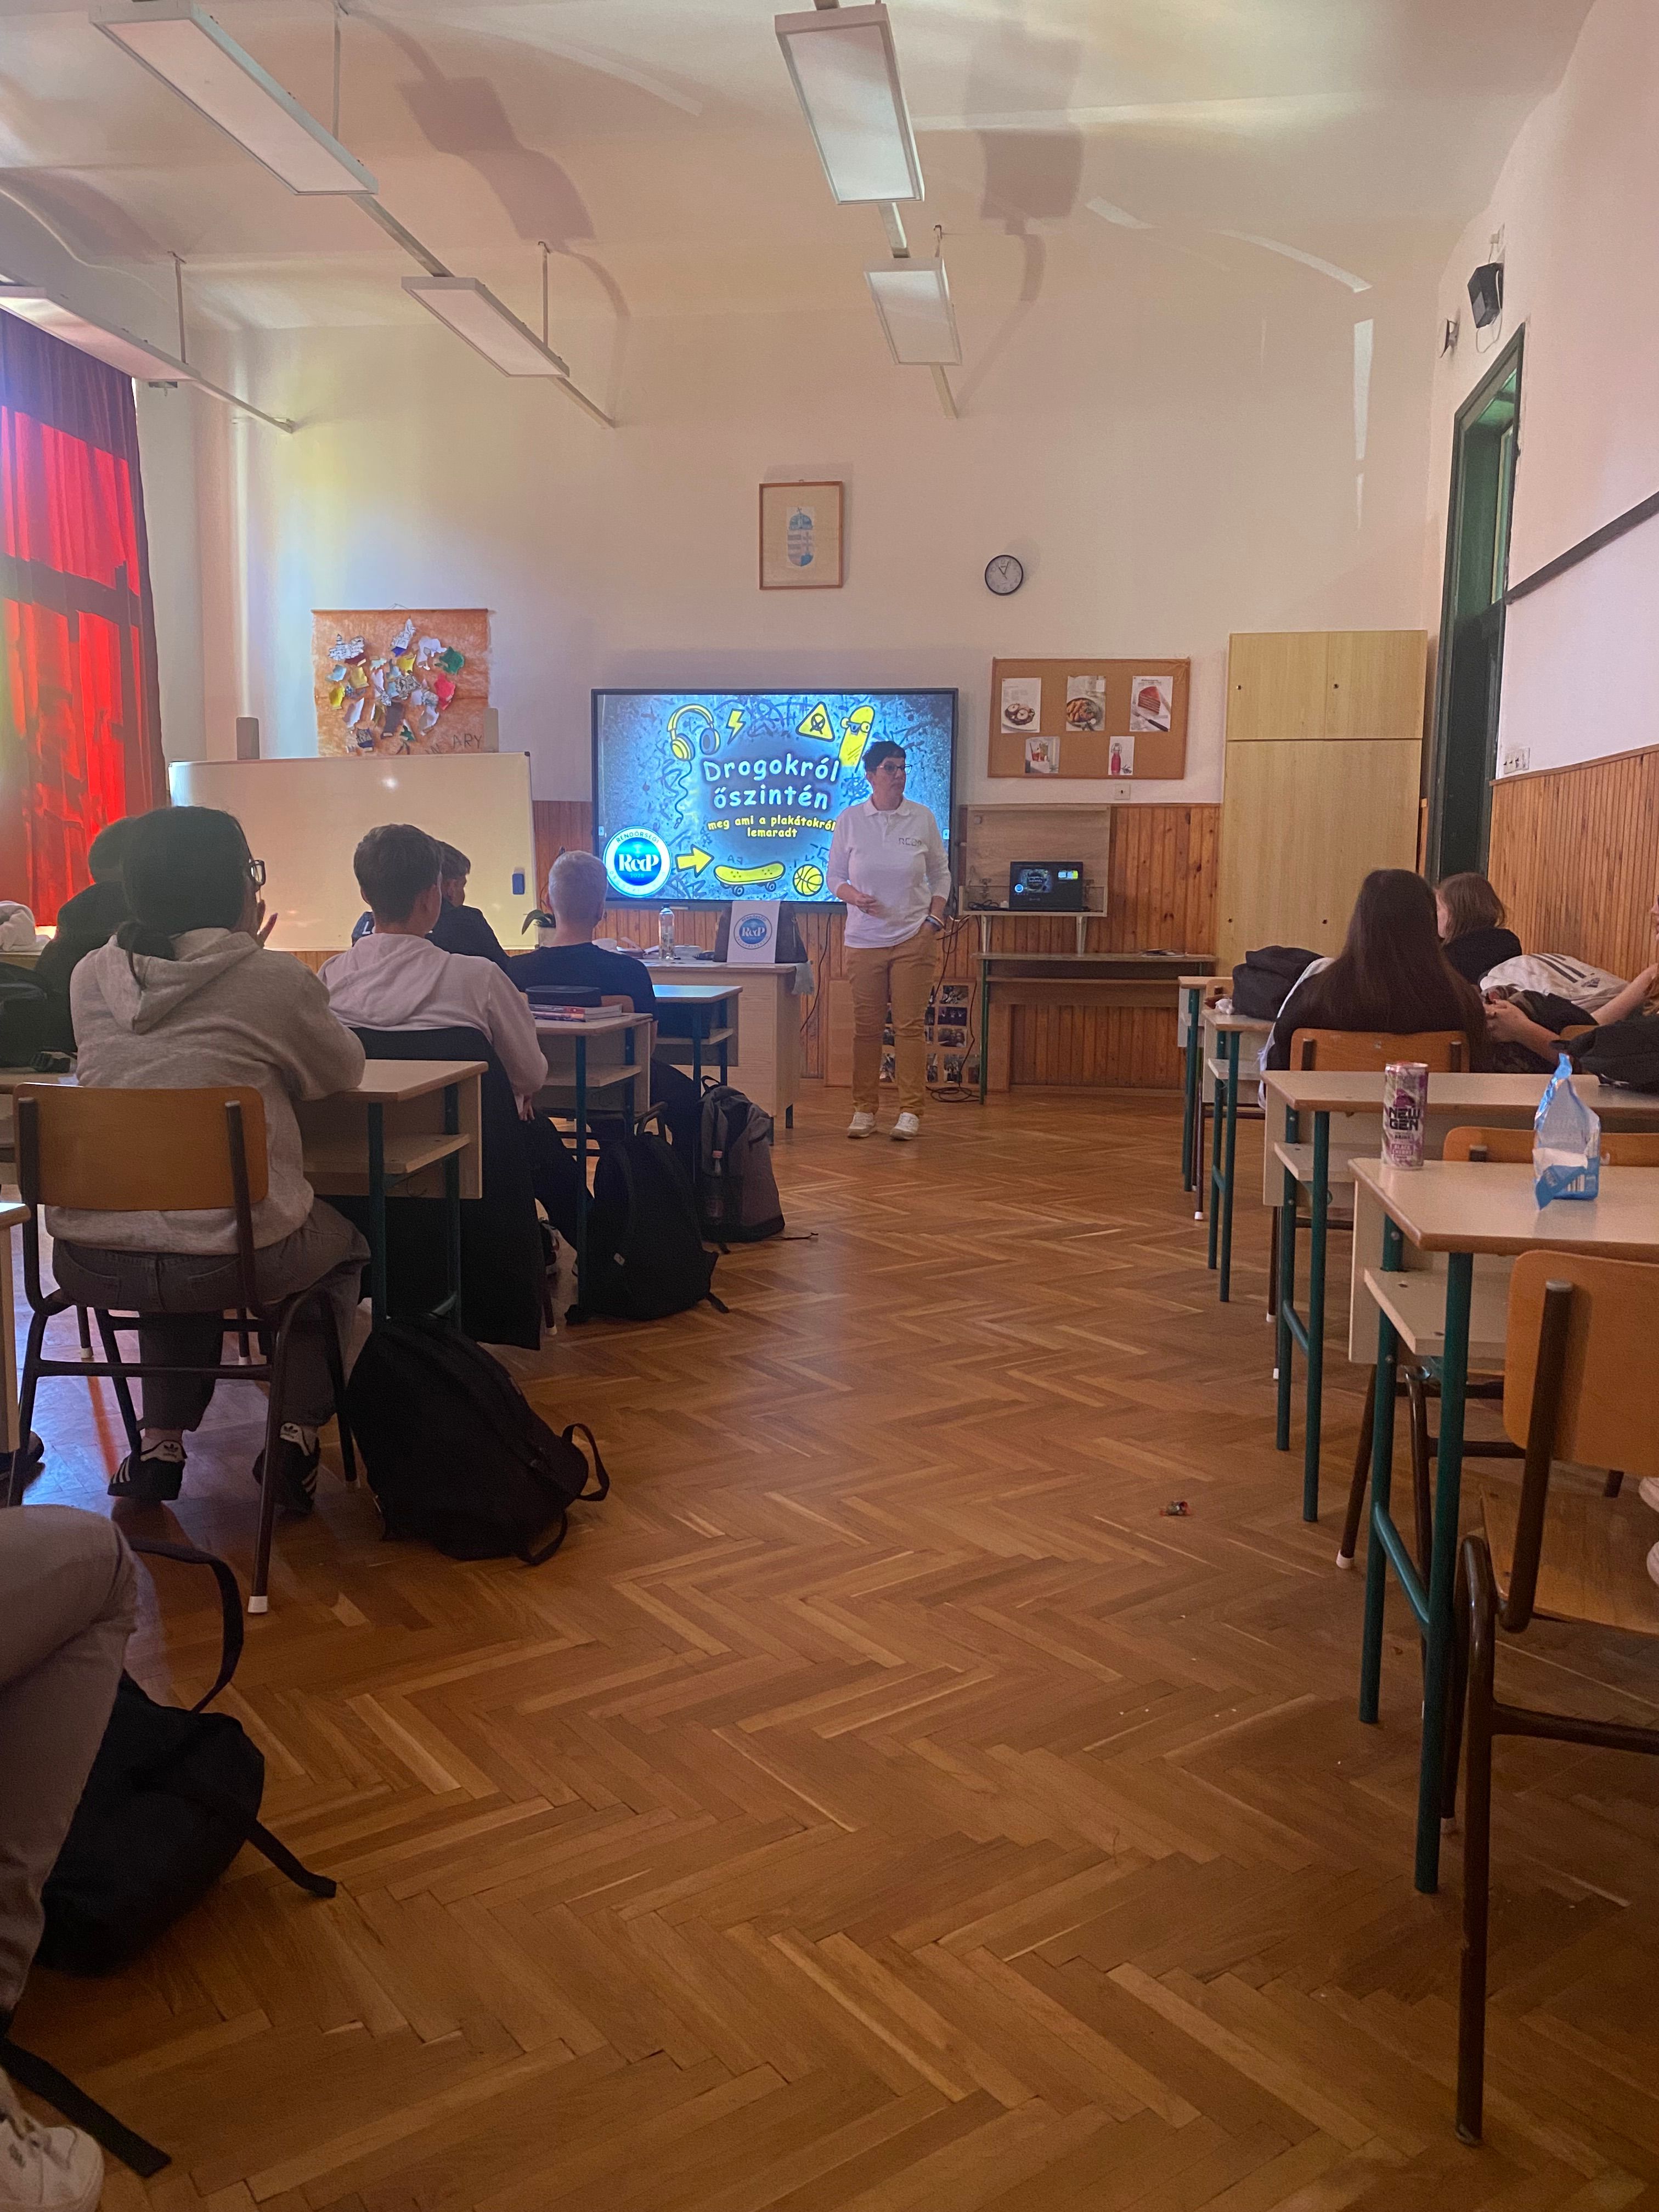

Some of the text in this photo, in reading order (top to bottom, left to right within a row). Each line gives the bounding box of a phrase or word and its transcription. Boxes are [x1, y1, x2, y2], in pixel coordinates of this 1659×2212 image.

[703, 753, 839, 782] Drogokról
[714, 784, 828, 810] őszintén
[708, 820, 730, 830] meg
[735, 815, 754, 826] ami
[771, 814, 836, 832] plakátokról
[747, 827, 798, 838] lemaradt
[1389, 1107, 1420, 1119] NEW
[1390, 1119, 1418, 1131] GEN
